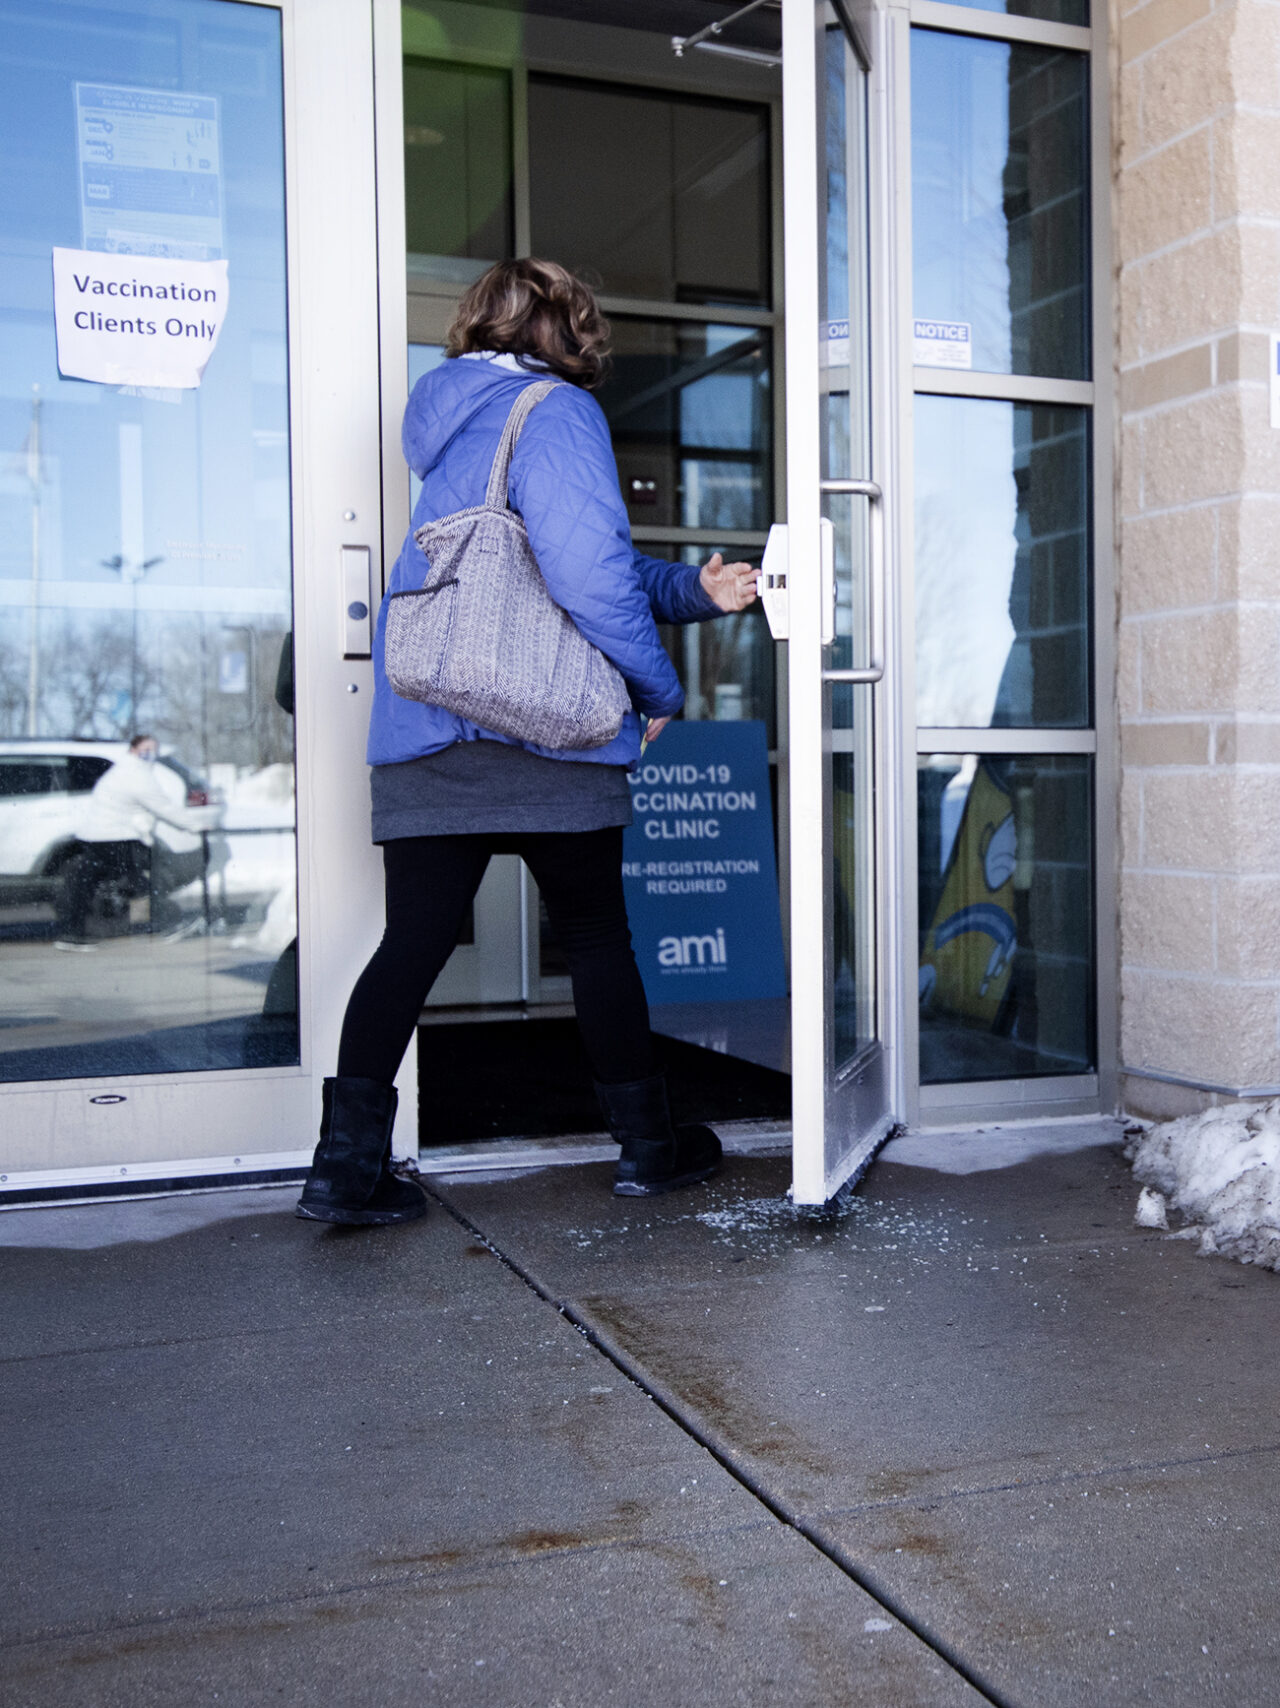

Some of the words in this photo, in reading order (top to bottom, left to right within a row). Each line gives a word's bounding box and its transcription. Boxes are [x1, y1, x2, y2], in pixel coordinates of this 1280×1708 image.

[73, 274, 216, 302] Vaccination
[74, 311, 157, 335] Clients
[165, 318, 216, 341] Only
[915, 323, 967, 341] NOTICE
[626, 765, 731, 785] COVID-19
[633, 791, 756, 813] CCINATION
[644, 819, 720, 840] CLINIC
[621, 860, 759, 877] RE-REGISTRATION
[646, 879, 727, 895] REQUIRED
[658, 928, 727, 967] ami
